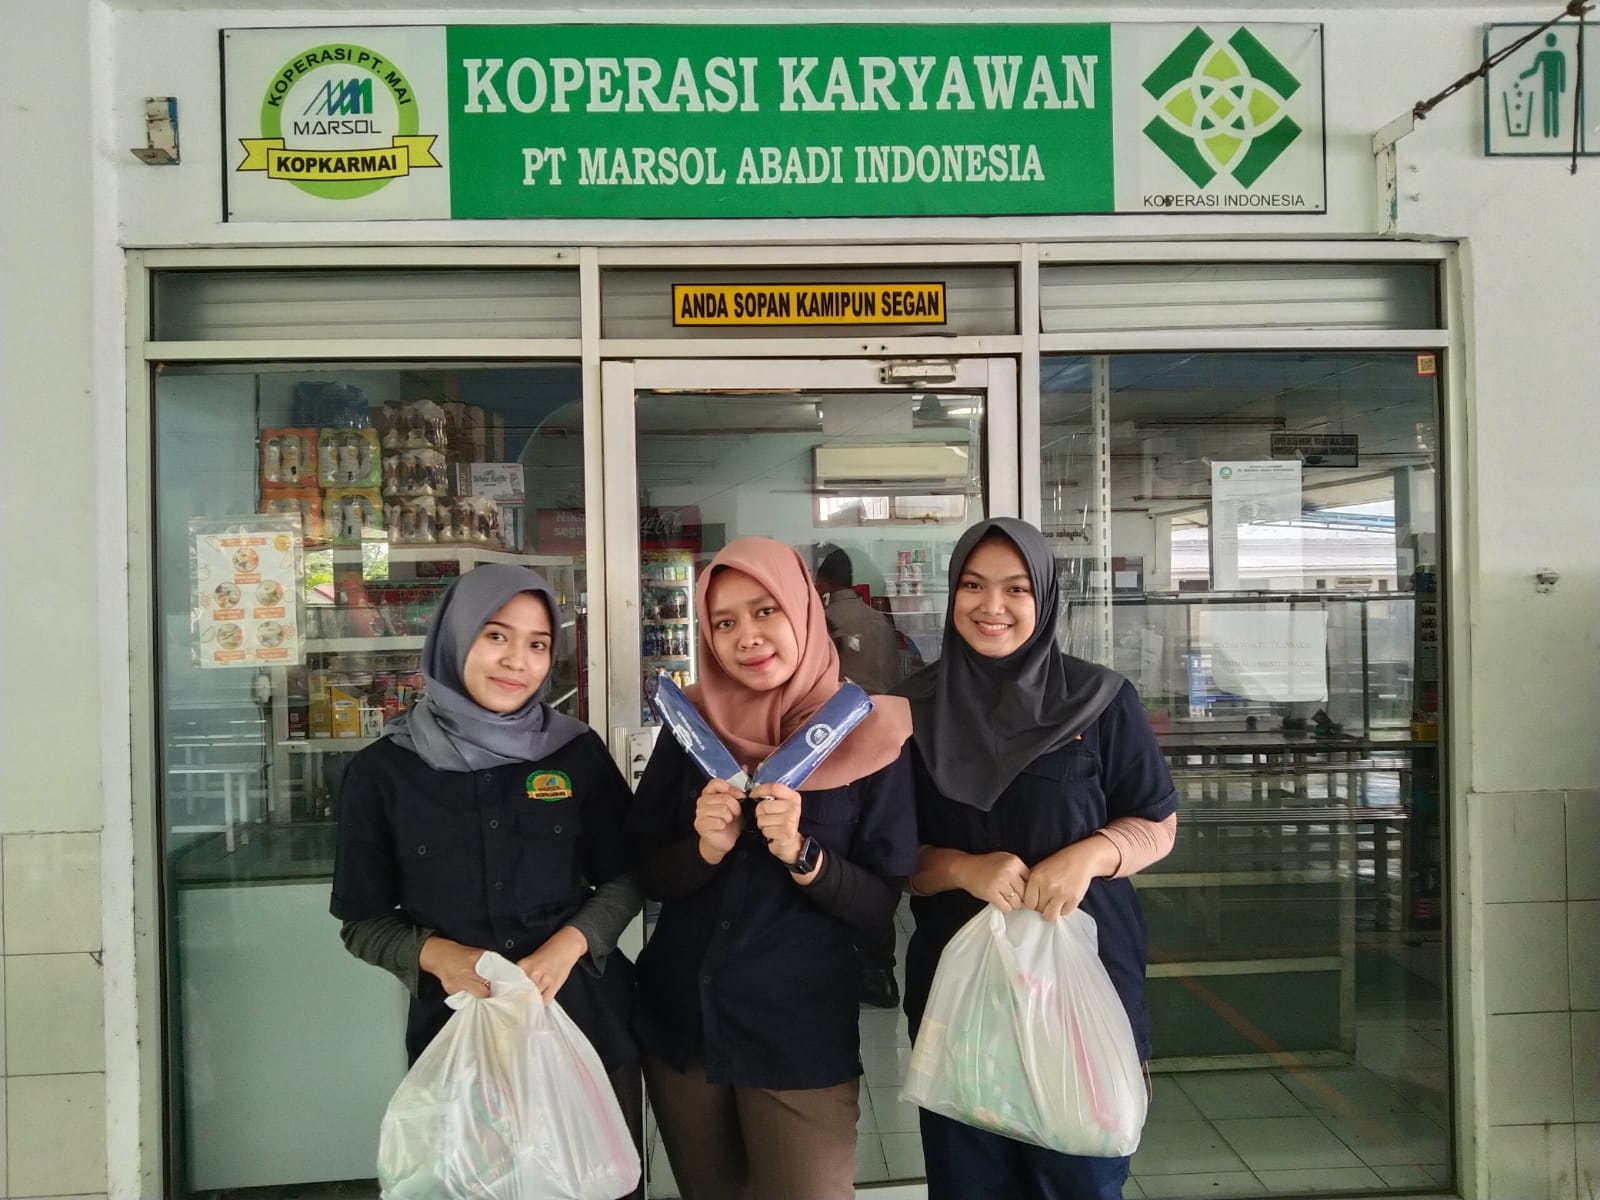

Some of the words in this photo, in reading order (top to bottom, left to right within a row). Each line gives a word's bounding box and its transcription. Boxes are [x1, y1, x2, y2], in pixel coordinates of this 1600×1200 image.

[268, 48, 352, 107] KOPERASI
[357, 51, 383, 73] PT.
[384, 70, 412, 105] MAI
[463, 56, 759, 113] KOPERASI
[779, 55, 1098, 112] KARYAWAN
[293, 120, 383, 136] MARSOL
[276, 154, 397, 174] KOPKARMAI
[522, 147, 567, 186] PT
[578, 147, 726, 185] MARSOL
[736, 146, 844, 185] ABADI
[854, 144, 1045, 183] INDONESIA
[1143, 194, 1219, 208] KOPERASI
[1224, 194, 1305, 207] INDONESIA
[681, 292, 729, 318] ANDA
[733, 291, 790, 318] SOPAN
[796, 291, 876, 317] KAMIPUN
[881, 290, 939, 316] SEGAN
